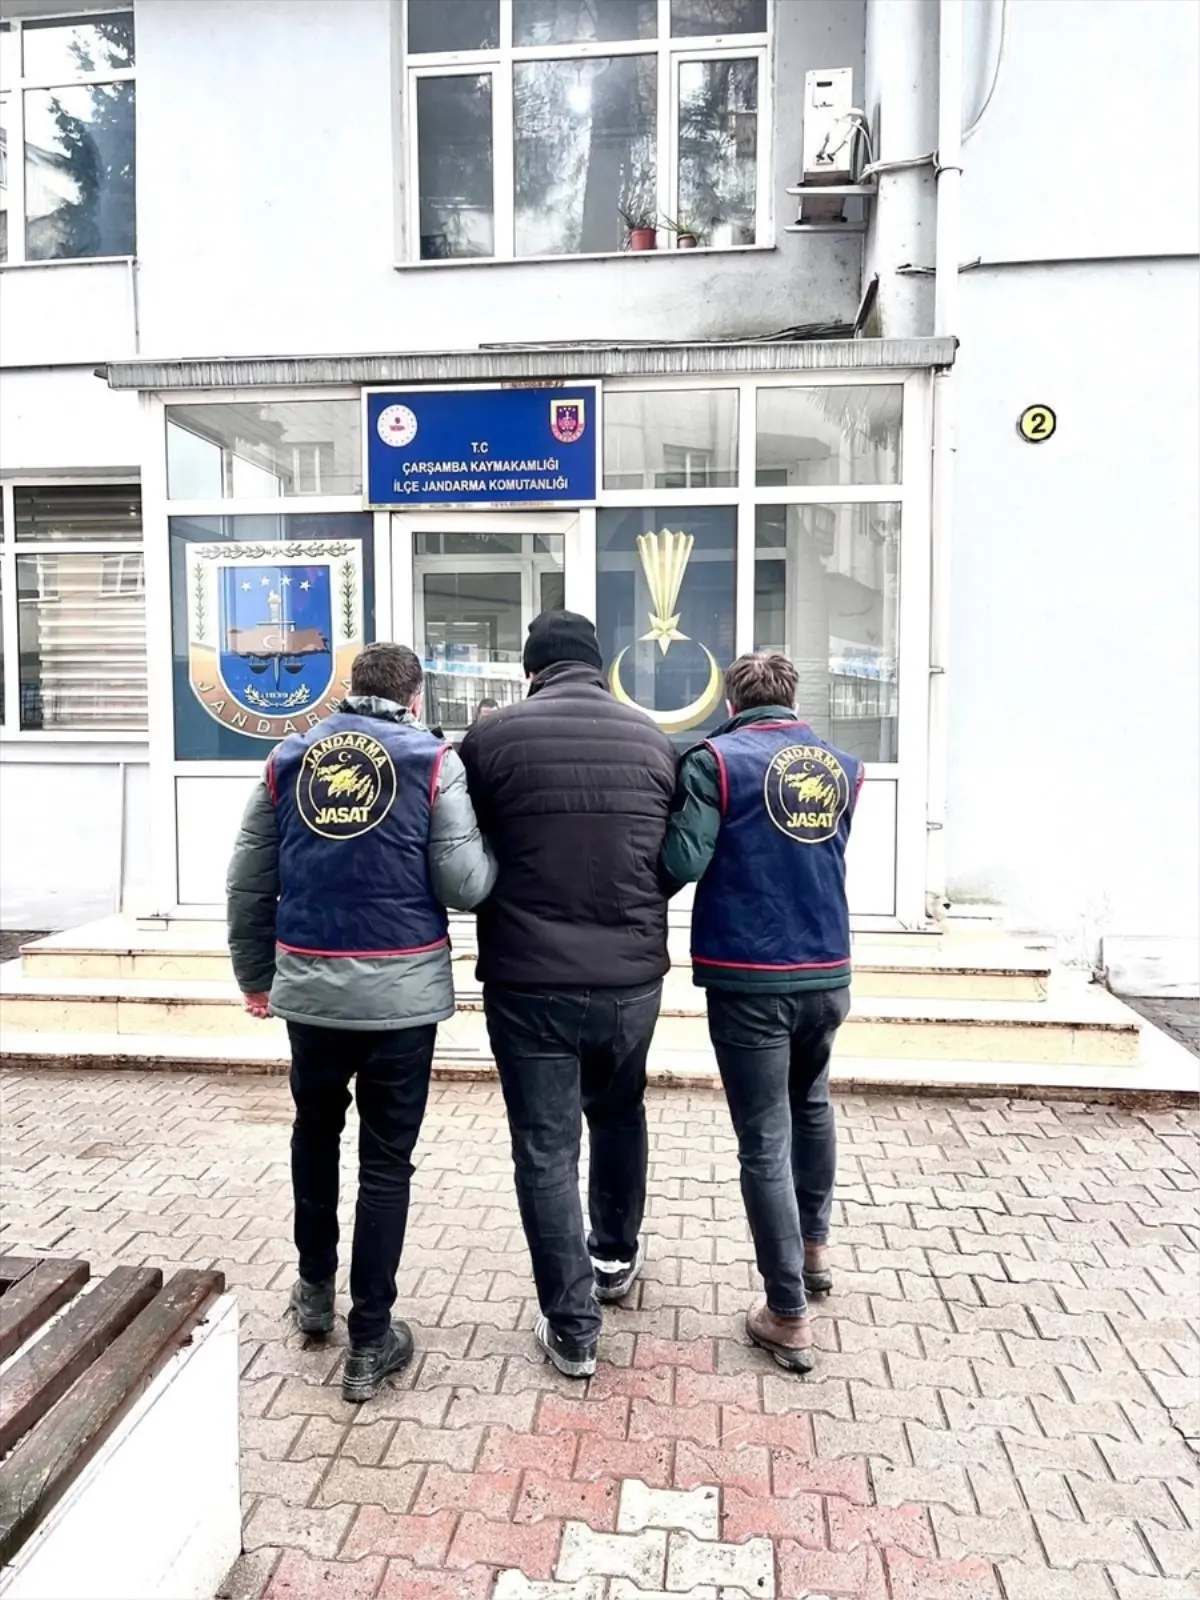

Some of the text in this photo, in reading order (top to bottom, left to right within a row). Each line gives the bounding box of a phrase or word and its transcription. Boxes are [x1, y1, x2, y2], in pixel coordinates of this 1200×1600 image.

[1031, 412, 1046, 434] 2
[402, 457, 559, 476] ÇARŞAMBA KAYMAKAMLIĞI
[393, 475, 569, 494] İLÇE JANDARMA KOMUTANLIĞI
[306, 734, 388, 769] JANDARMA
[772, 747, 843, 780] JANDARMA
[315, 805, 371, 825] JASAT
[786, 811, 834, 828] JASAT
